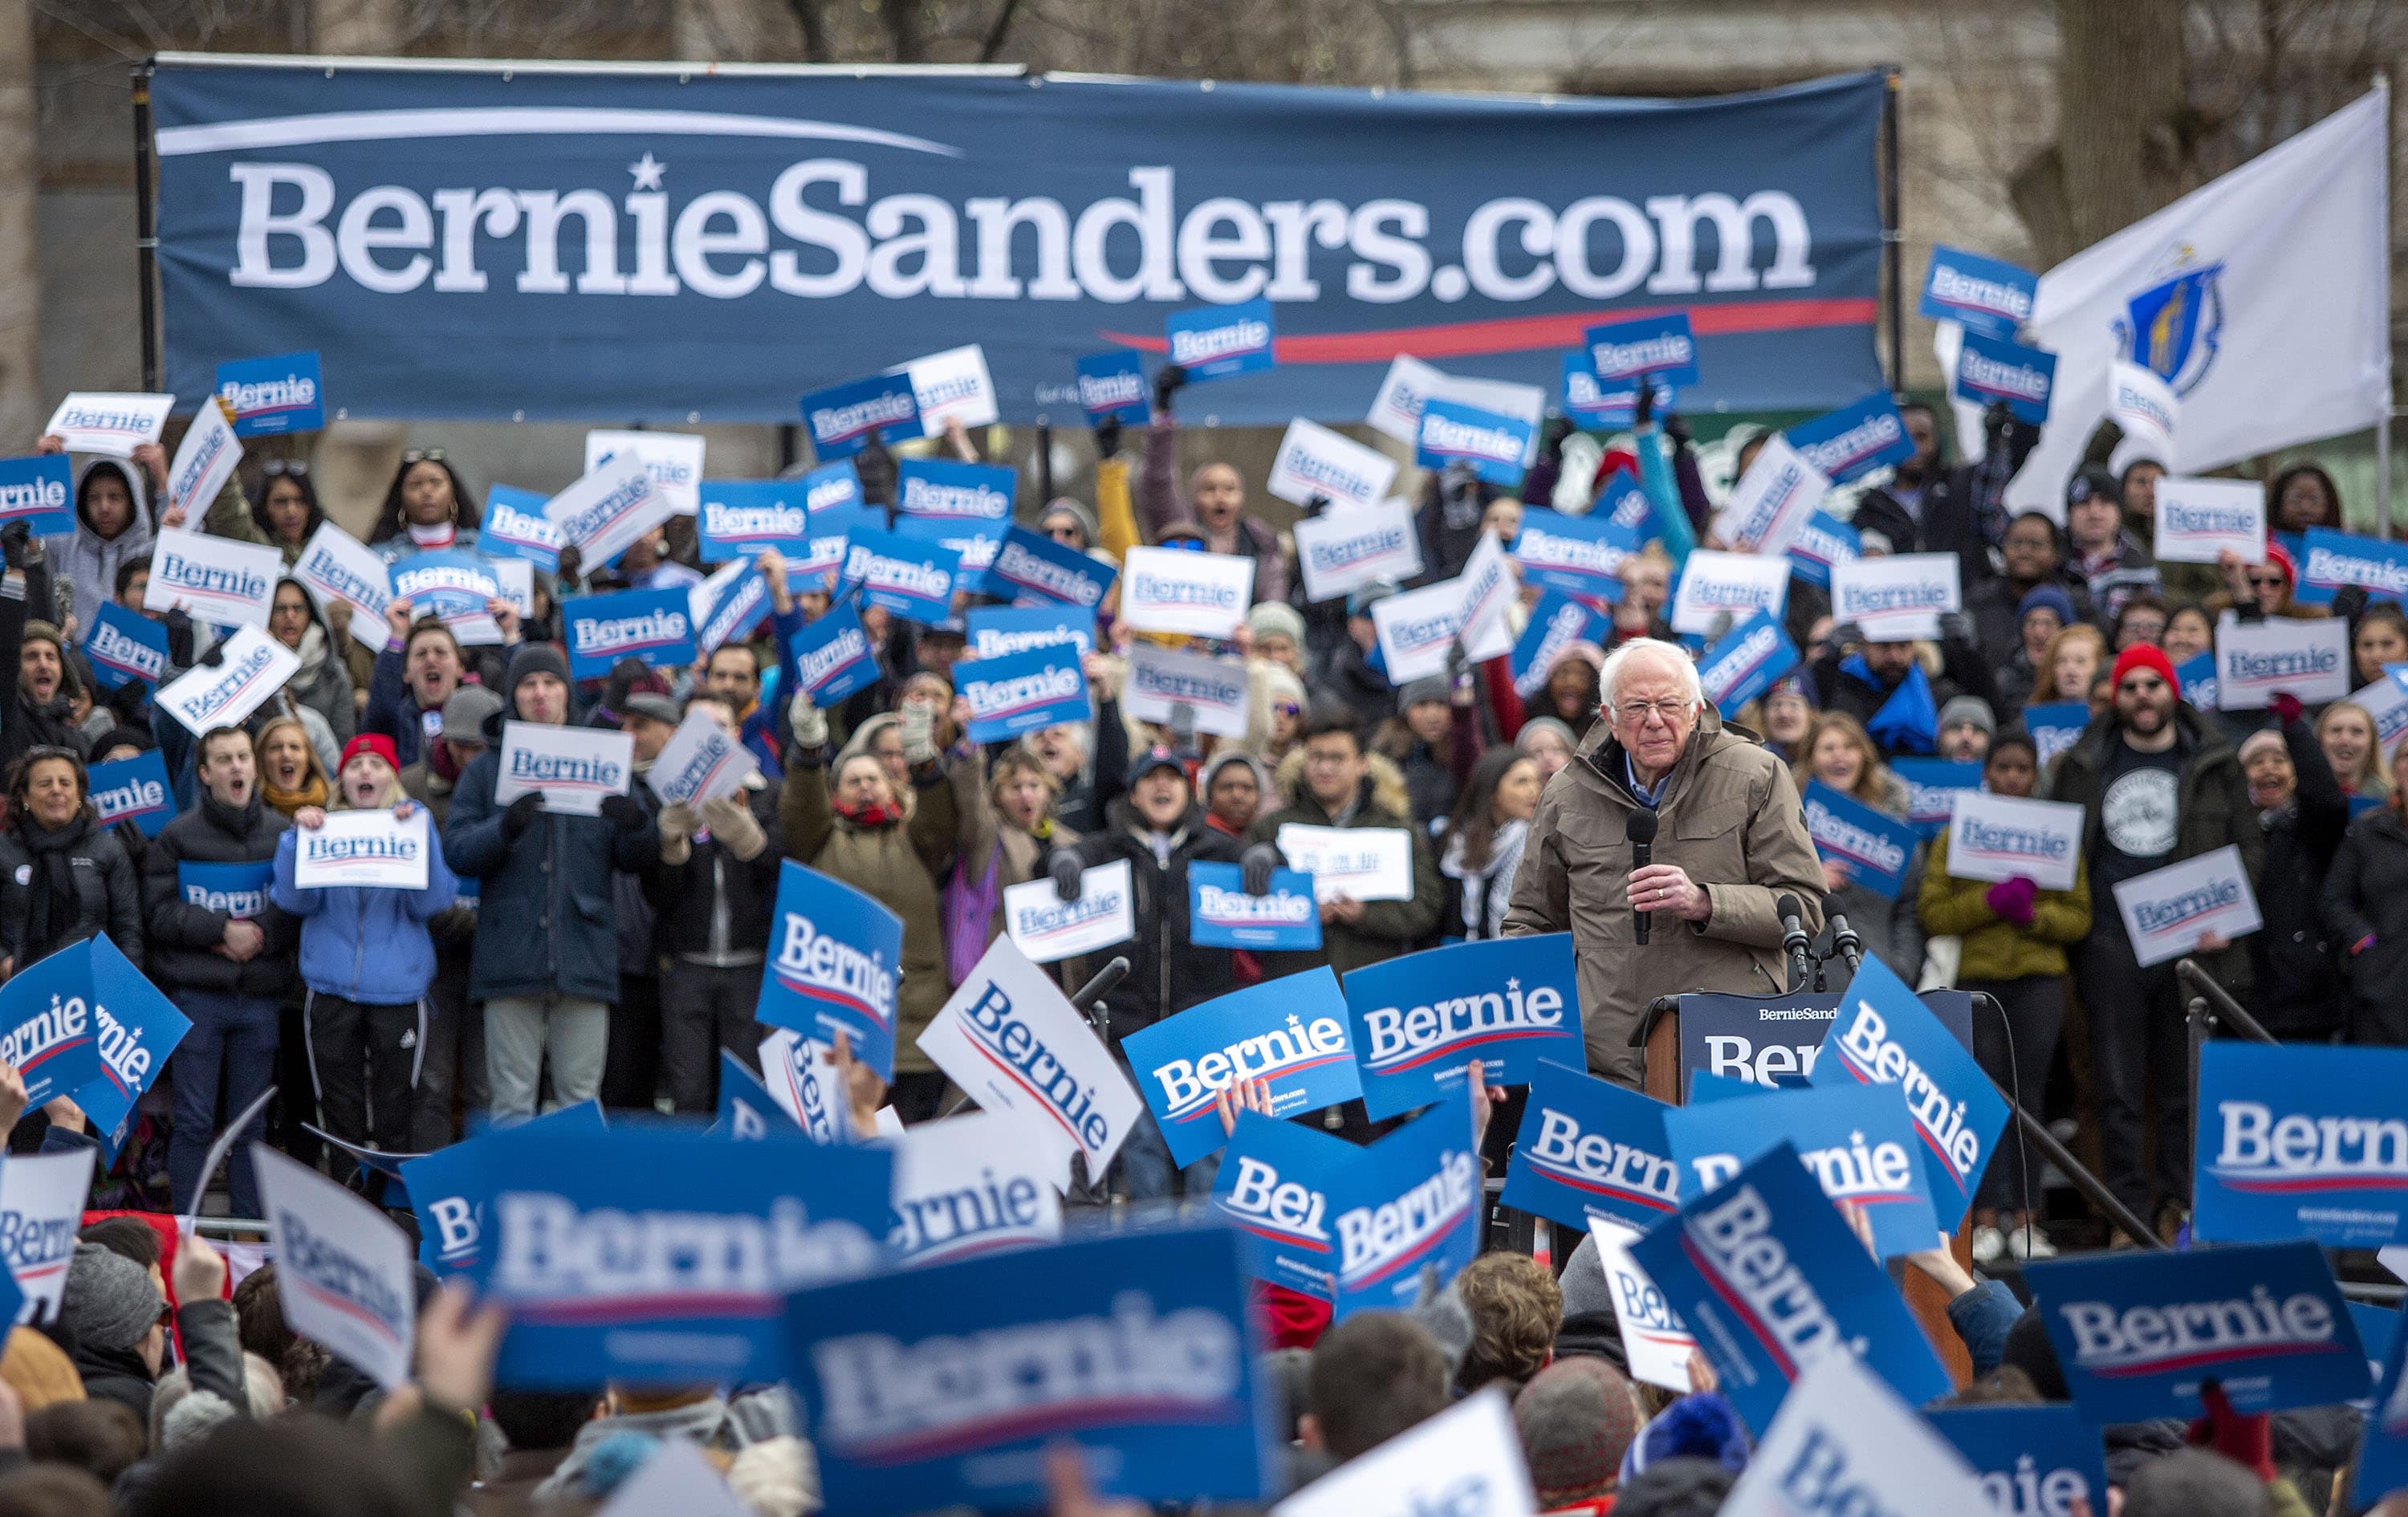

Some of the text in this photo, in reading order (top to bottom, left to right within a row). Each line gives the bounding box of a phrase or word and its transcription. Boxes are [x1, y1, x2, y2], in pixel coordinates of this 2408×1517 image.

[230, 152, 1814, 303] BernieSanders.com
[1172, 318, 1269, 363] Bernie
[61, 409, 155, 434] Bernie
[811, 390, 917, 441] Bernie
[1422, 413, 1523, 462] Bernie
[0, 475, 67, 508] rnie
[1284, 445, 1374, 498] Bernie
[563, 474, 649, 541] Bernie
[703, 502, 806, 535] Bernie
[905, 477, 1011, 520] Bernie
[2166, 501, 2255, 532] Bernie
[845, 545, 951, 598] Bernie
[997, 540, 1103, 606] Bernie
[1311, 526, 1405, 571] Bernie
[161, 552, 267, 600] Bernie
[395, 564, 500, 600] Bernie
[1134, 572, 1239, 610] Bernie
[1690, 575, 1773, 607] Bernie
[1841, 578, 1948, 612] Bernie
[94, 620, 166, 674] Bern
[573, 607, 688, 652] Bernie
[181, 645, 275, 721] Bernie
[799, 628, 866, 685] Bernie
[1700, 624, 1778, 691] ernie
[2227, 645, 2338, 679] Bernie
[966, 665, 1080, 714] Bernie
[1135, 661, 1241, 706] Bernie
[510, 746, 620, 787] Bernie
[307, 834, 417, 861] Bernie
[1805, 799, 1905, 872] Bernie
[1960, 815, 2070, 859] Bernie
[1019, 887, 1121, 934] Bernie
[1198, 884, 1312, 923] Bernie
[2132, 876, 2239, 933] Bernie
[778, 911, 895, 1017] Bernie
[0, 992, 87, 1068] ernie
[1363, 975, 1564, 1059] Bernie
[1759, 1007, 1839, 1021] BernieSand
[963, 978, 1108, 1152] Bernie
[1153, 1011, 1346, 1111] Bernie
[1704, 1035, 1824, 1090] Ber
[1841, 998, 1980, 1176] Bernie
[790, 1035, 832, 1146] Ber
[1530, 1107, 1680, 1202] Bern
[2215, 1100, 2408, 1170] Bern
[1334, 1148, 1477, 1272] Bernie
[491, 1190, 877, 1295] Bernie
[1694, 1181, 1872, 1362] Berni
[2060, 1283, 2337, 1363] Bernie
[805, 1289, 1243, 1445] Bernie
